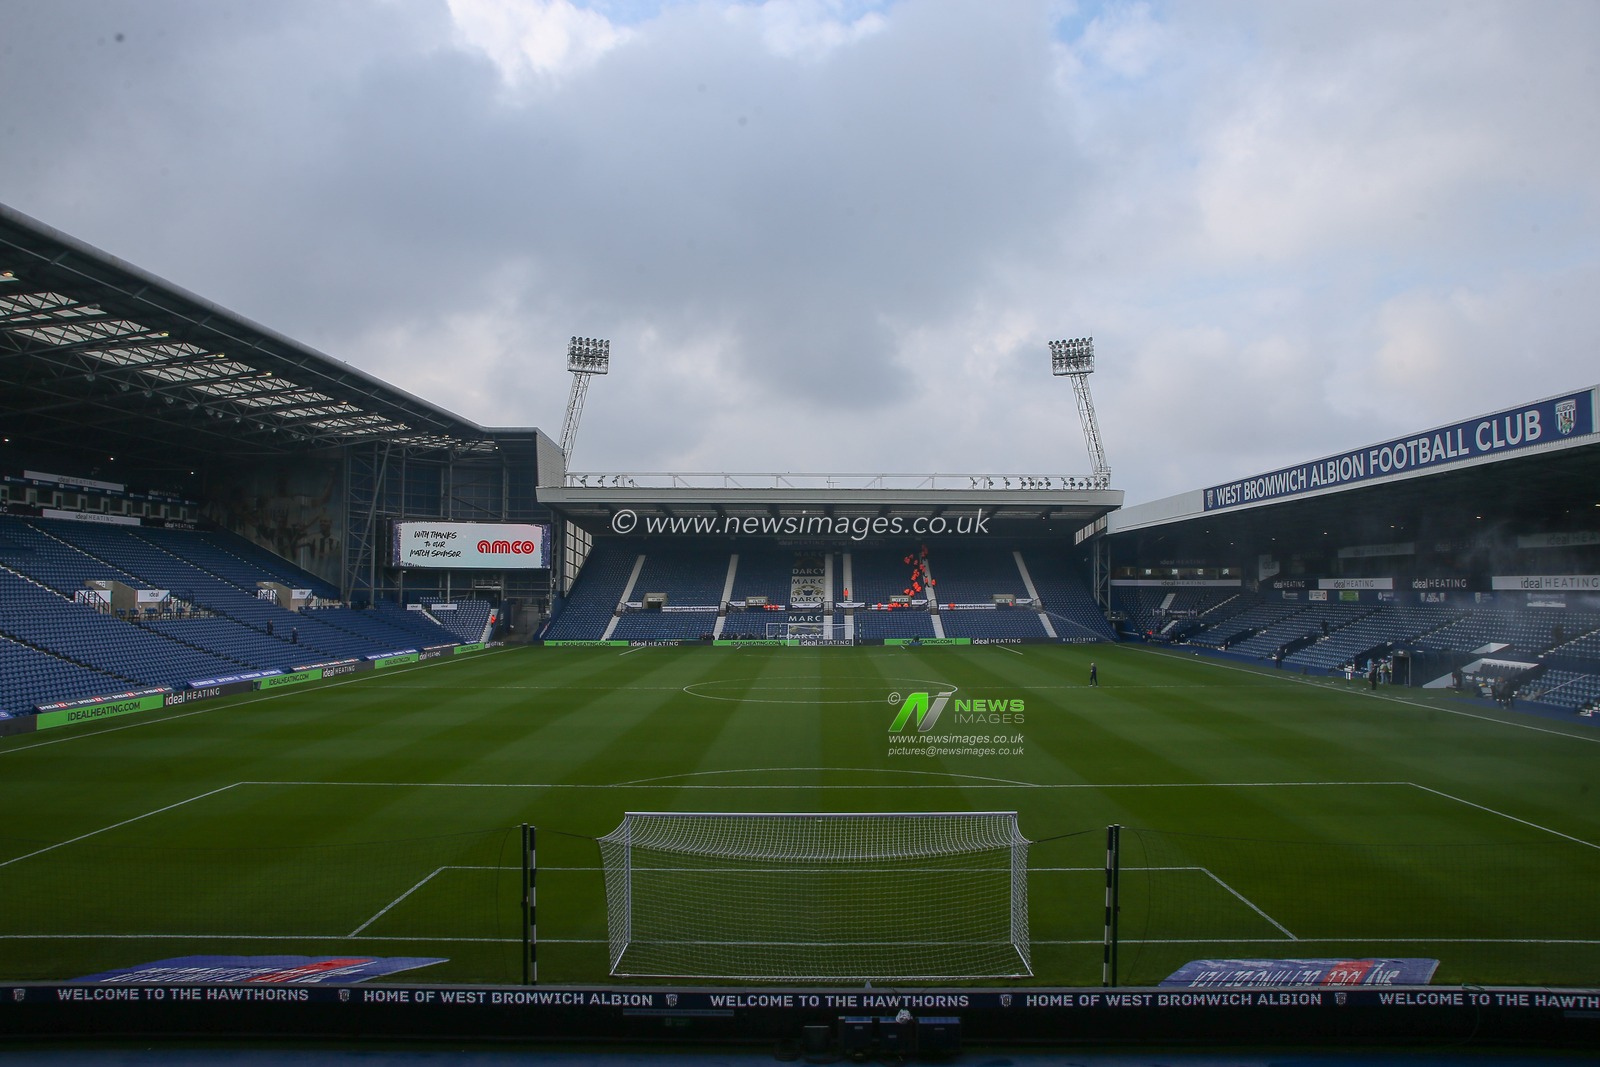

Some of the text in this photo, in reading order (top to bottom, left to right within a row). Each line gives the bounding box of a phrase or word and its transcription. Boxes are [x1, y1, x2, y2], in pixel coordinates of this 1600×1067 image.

[1216, 410, 1542, 506] WEST BROMWICH ALBION FOOTBALL CLUB
[430, 530, 457, 539] THANKS
[477, 540, 535, 554] amco
[409, 550, 462, 558] MATCH SPONSOR
[1334, 580, 1374, 589] ideal HEATING
[1412, 578, 1467, 589] ideal HEATING
[1520, 577, 1599, 589] ideal HEATING
[323, 667, 335, 678] ideal
[335, 665, 355, 675] HEATING
[269, 673, 309, 686] IDEALHEATING.COM
[165, 687, 220, 706] ideal HEATING
[67, 701, 140, 721] IDEALHEATING.COM
[57, 988, 309, 1001] WELCOME TO THE HAWTHORNS
[364, 990, 653, 1007] HOME OF WEST BROMWICH ALBION
[710, 995, 969, 1007] WELCOME TO THE HAWTHORNS
[1026, 993, 1322, 1007] HOME OF WEST BROMWICH ALBION
[1378, 993, 1600, 1008] WELCOME TO THE HAWTH
